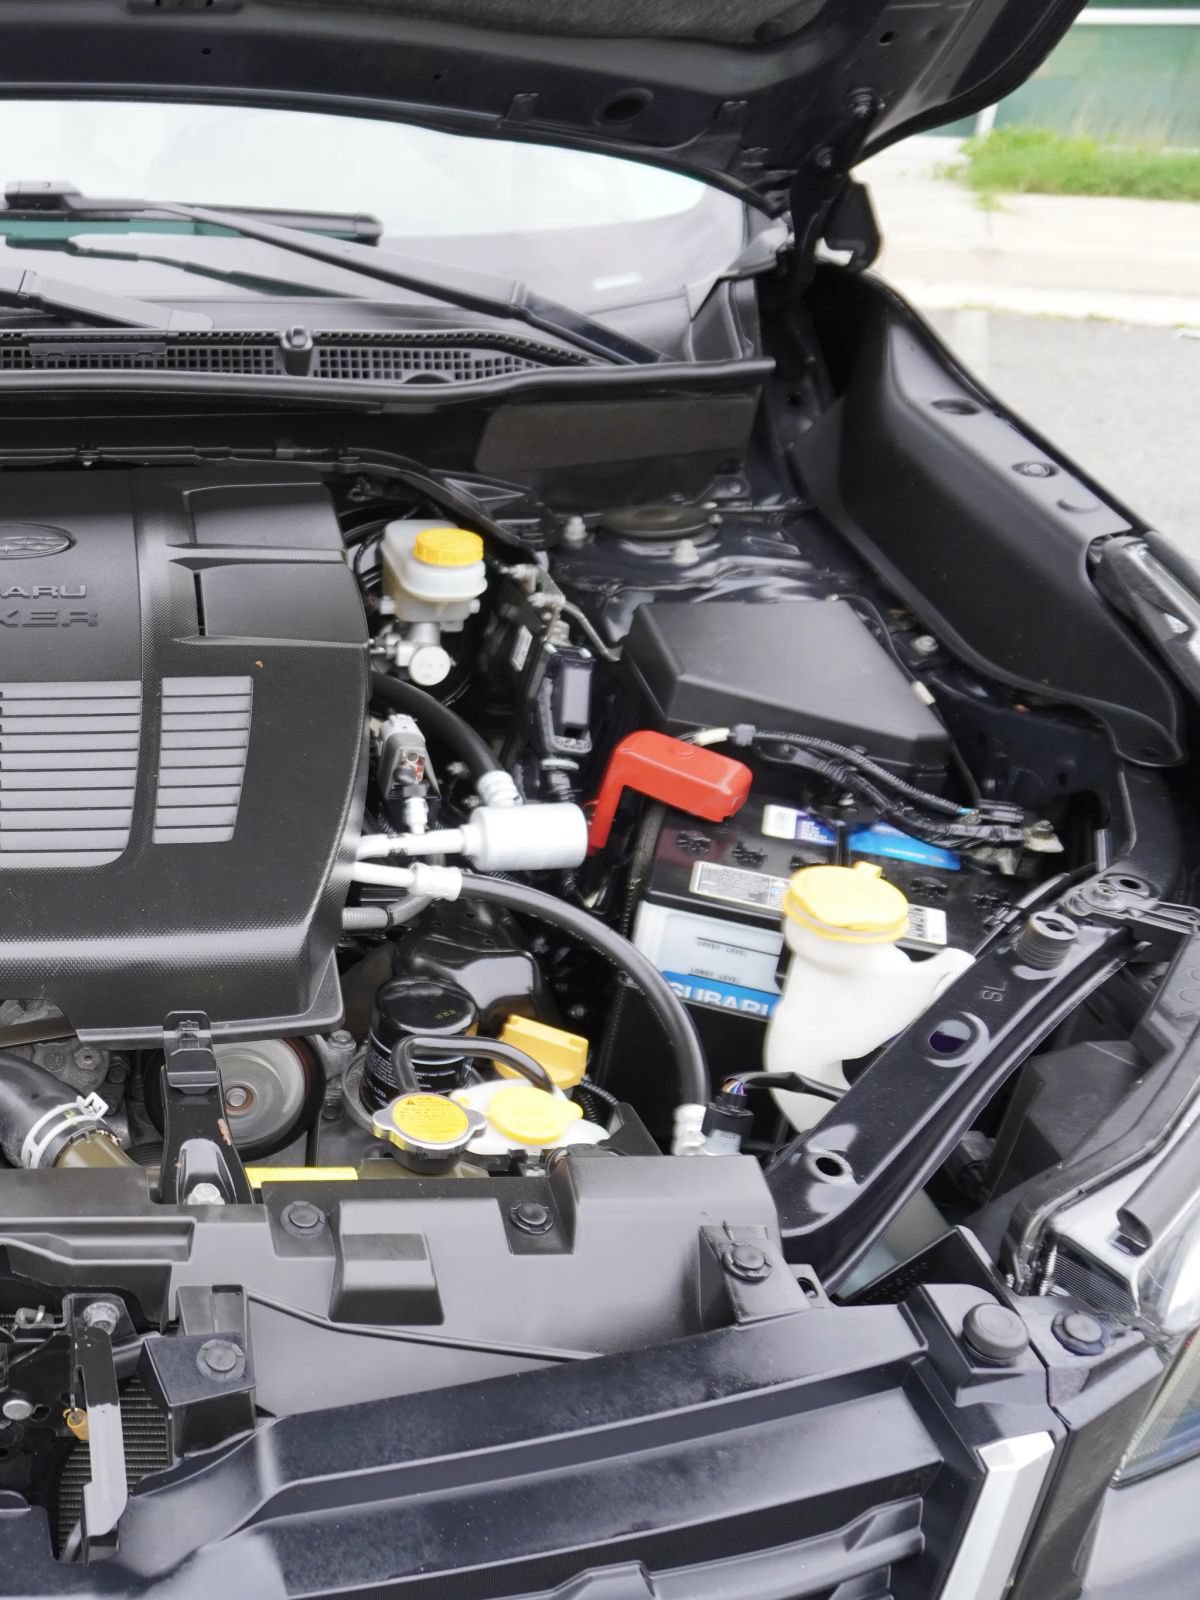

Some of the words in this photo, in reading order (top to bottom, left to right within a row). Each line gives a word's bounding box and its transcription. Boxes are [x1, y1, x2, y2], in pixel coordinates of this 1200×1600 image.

[725, 947, 748, 957] LEVEL
[690, 967, 714, 977] LOWER
[719, 973, 740, 983] LEVEL
[982, 981, 1007, 1002] SL
